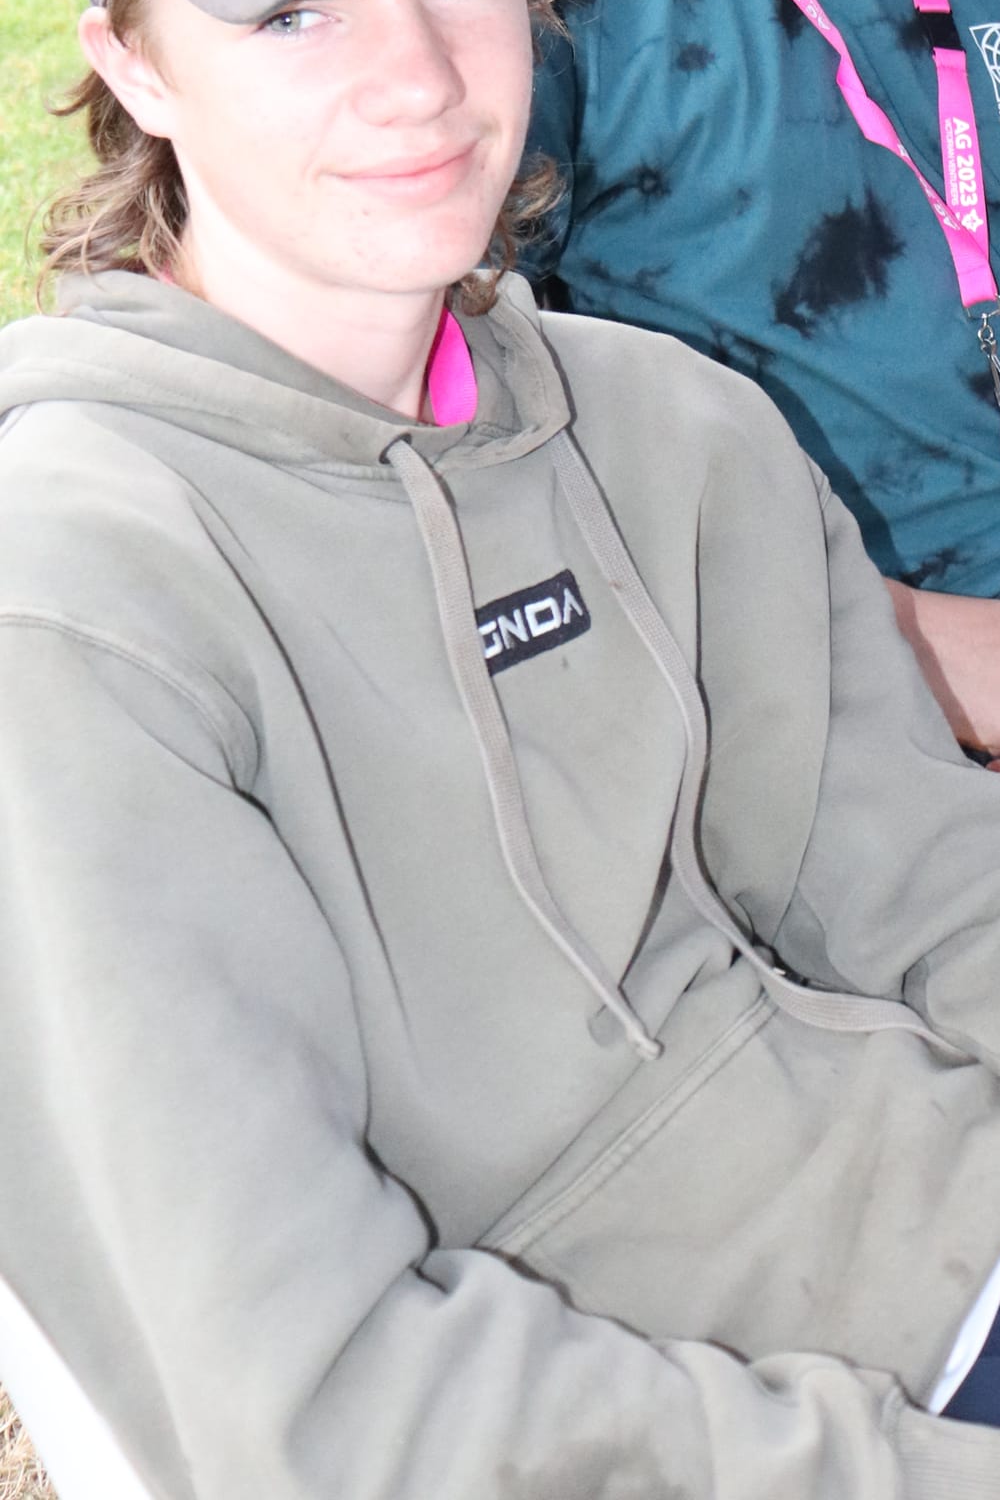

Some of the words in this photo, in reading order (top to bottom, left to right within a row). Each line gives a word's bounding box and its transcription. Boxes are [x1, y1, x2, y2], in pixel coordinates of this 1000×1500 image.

[806, 4, 831, 31] AG
[952, 117, 972, 150] AG
[956, 154, 978, 207] 2023
